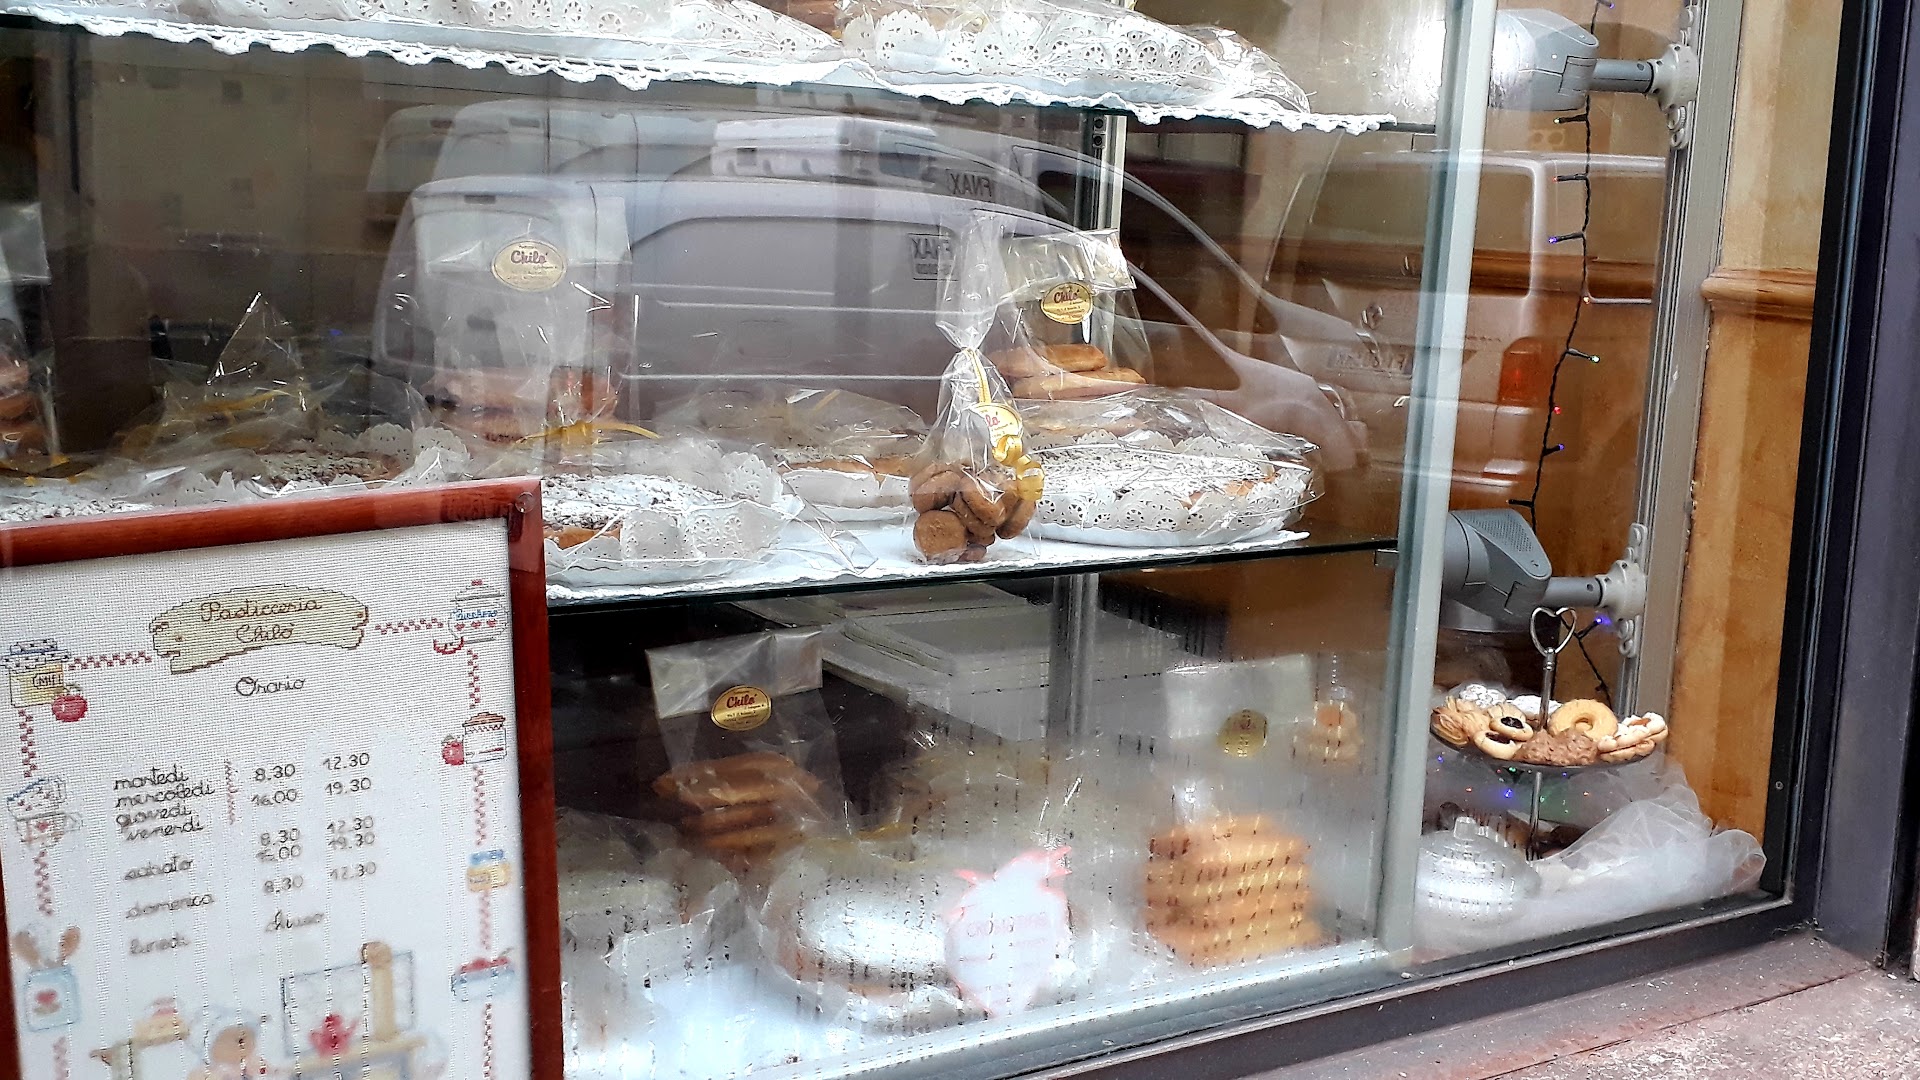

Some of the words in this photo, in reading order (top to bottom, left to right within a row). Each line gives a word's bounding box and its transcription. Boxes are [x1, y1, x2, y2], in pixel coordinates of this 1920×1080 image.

[200, 598, 323, 622] Pasticceria
[236, 675, 306, 697] Orario
[255, 764, 296, 781] 8.30
[323, 752, 370, 771] 12.30
[325, 777, 372, 796] 19.30
[260, 828, 300, 846] 8.30
[264, 875, 304, 894] 8.30
[330, 861, 377, 880] 12.30
